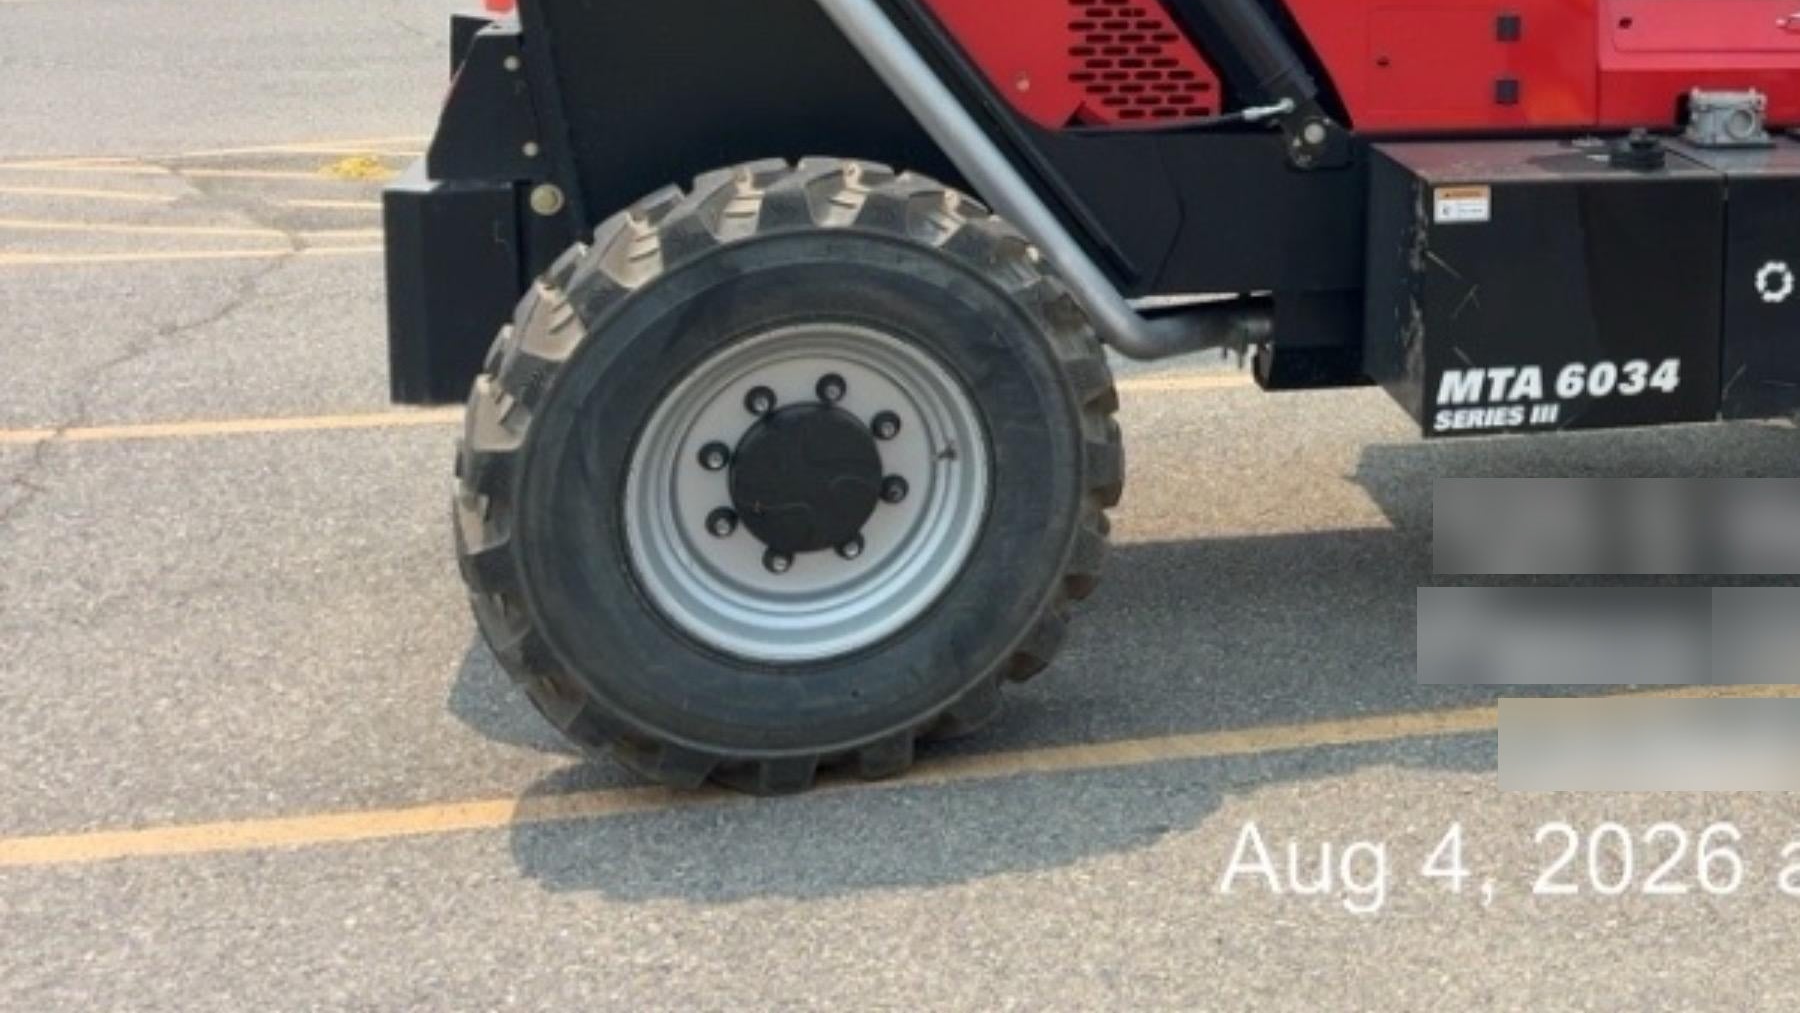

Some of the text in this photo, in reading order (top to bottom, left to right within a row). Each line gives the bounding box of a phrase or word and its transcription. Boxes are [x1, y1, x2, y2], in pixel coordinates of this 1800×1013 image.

[1436, 358, 1680, 405] MTA 6034
[1433, 403, 1560, 431] SERIES III
